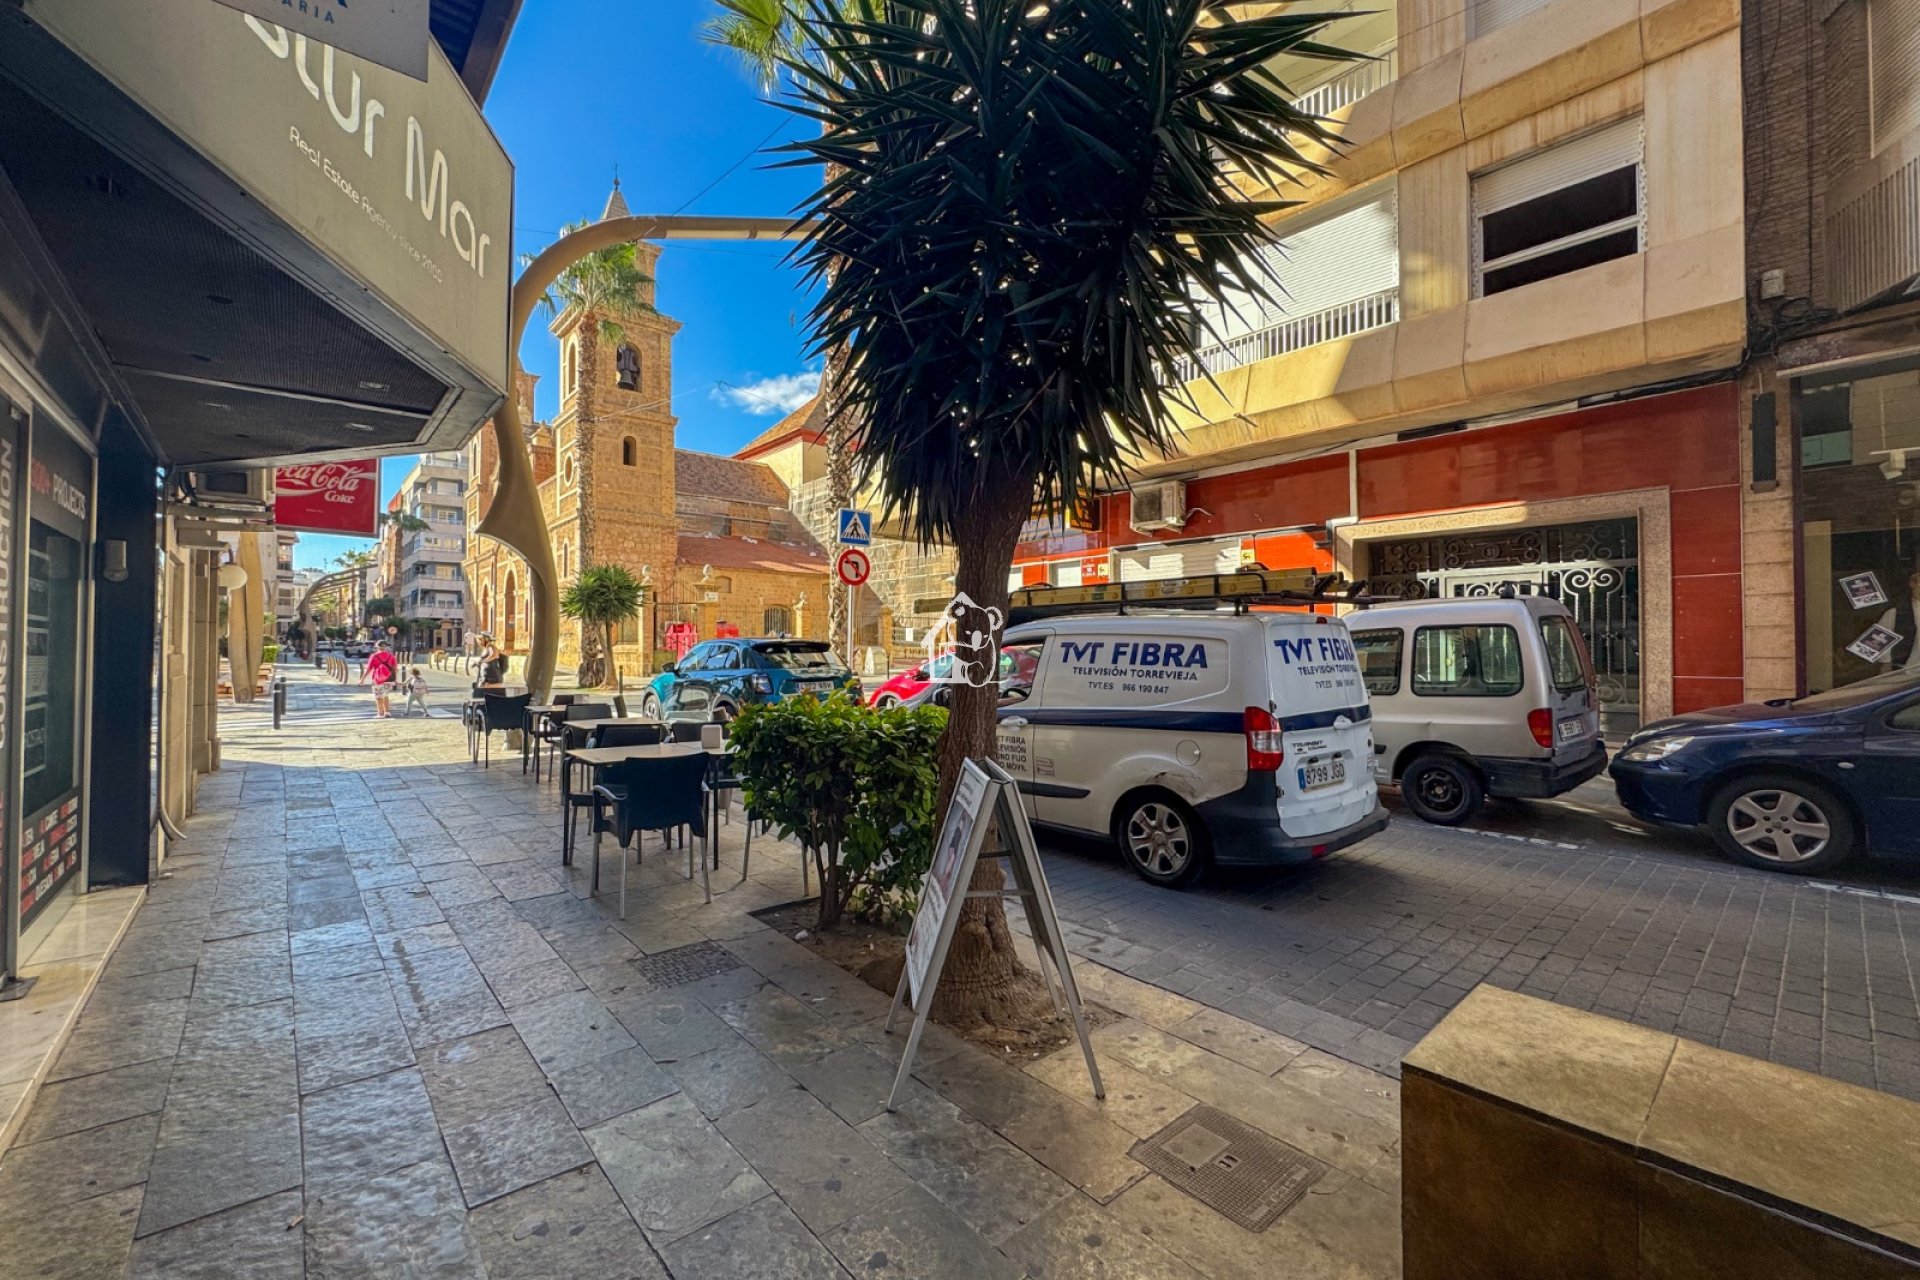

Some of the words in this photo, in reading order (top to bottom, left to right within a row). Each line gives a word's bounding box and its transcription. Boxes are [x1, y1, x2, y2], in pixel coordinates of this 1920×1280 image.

[289, 125, 321, 168] Real
[323, 158, 361, 204] Estate
[361, 196, 397, 240] Agency
[405, 115, 491, 279] Mar
[324, 490, 356, 504] Coke
[1060, 641, 1105, 664] TVT
[1111, 642, 1208, 669] FIBRA
[1273, 637, 1313, 664] TVT
[1072, 665, 1128, 677] TELEVISIÓN
[1130, 668, 1199, 681] TORREVIEJA
[1121, 683, 1136, 692] 966
[1153, 685, 1169, 694] 847
[1005, 735, 1026, 745] FIBRA
[1305, 766, 1328, 785] 8799
